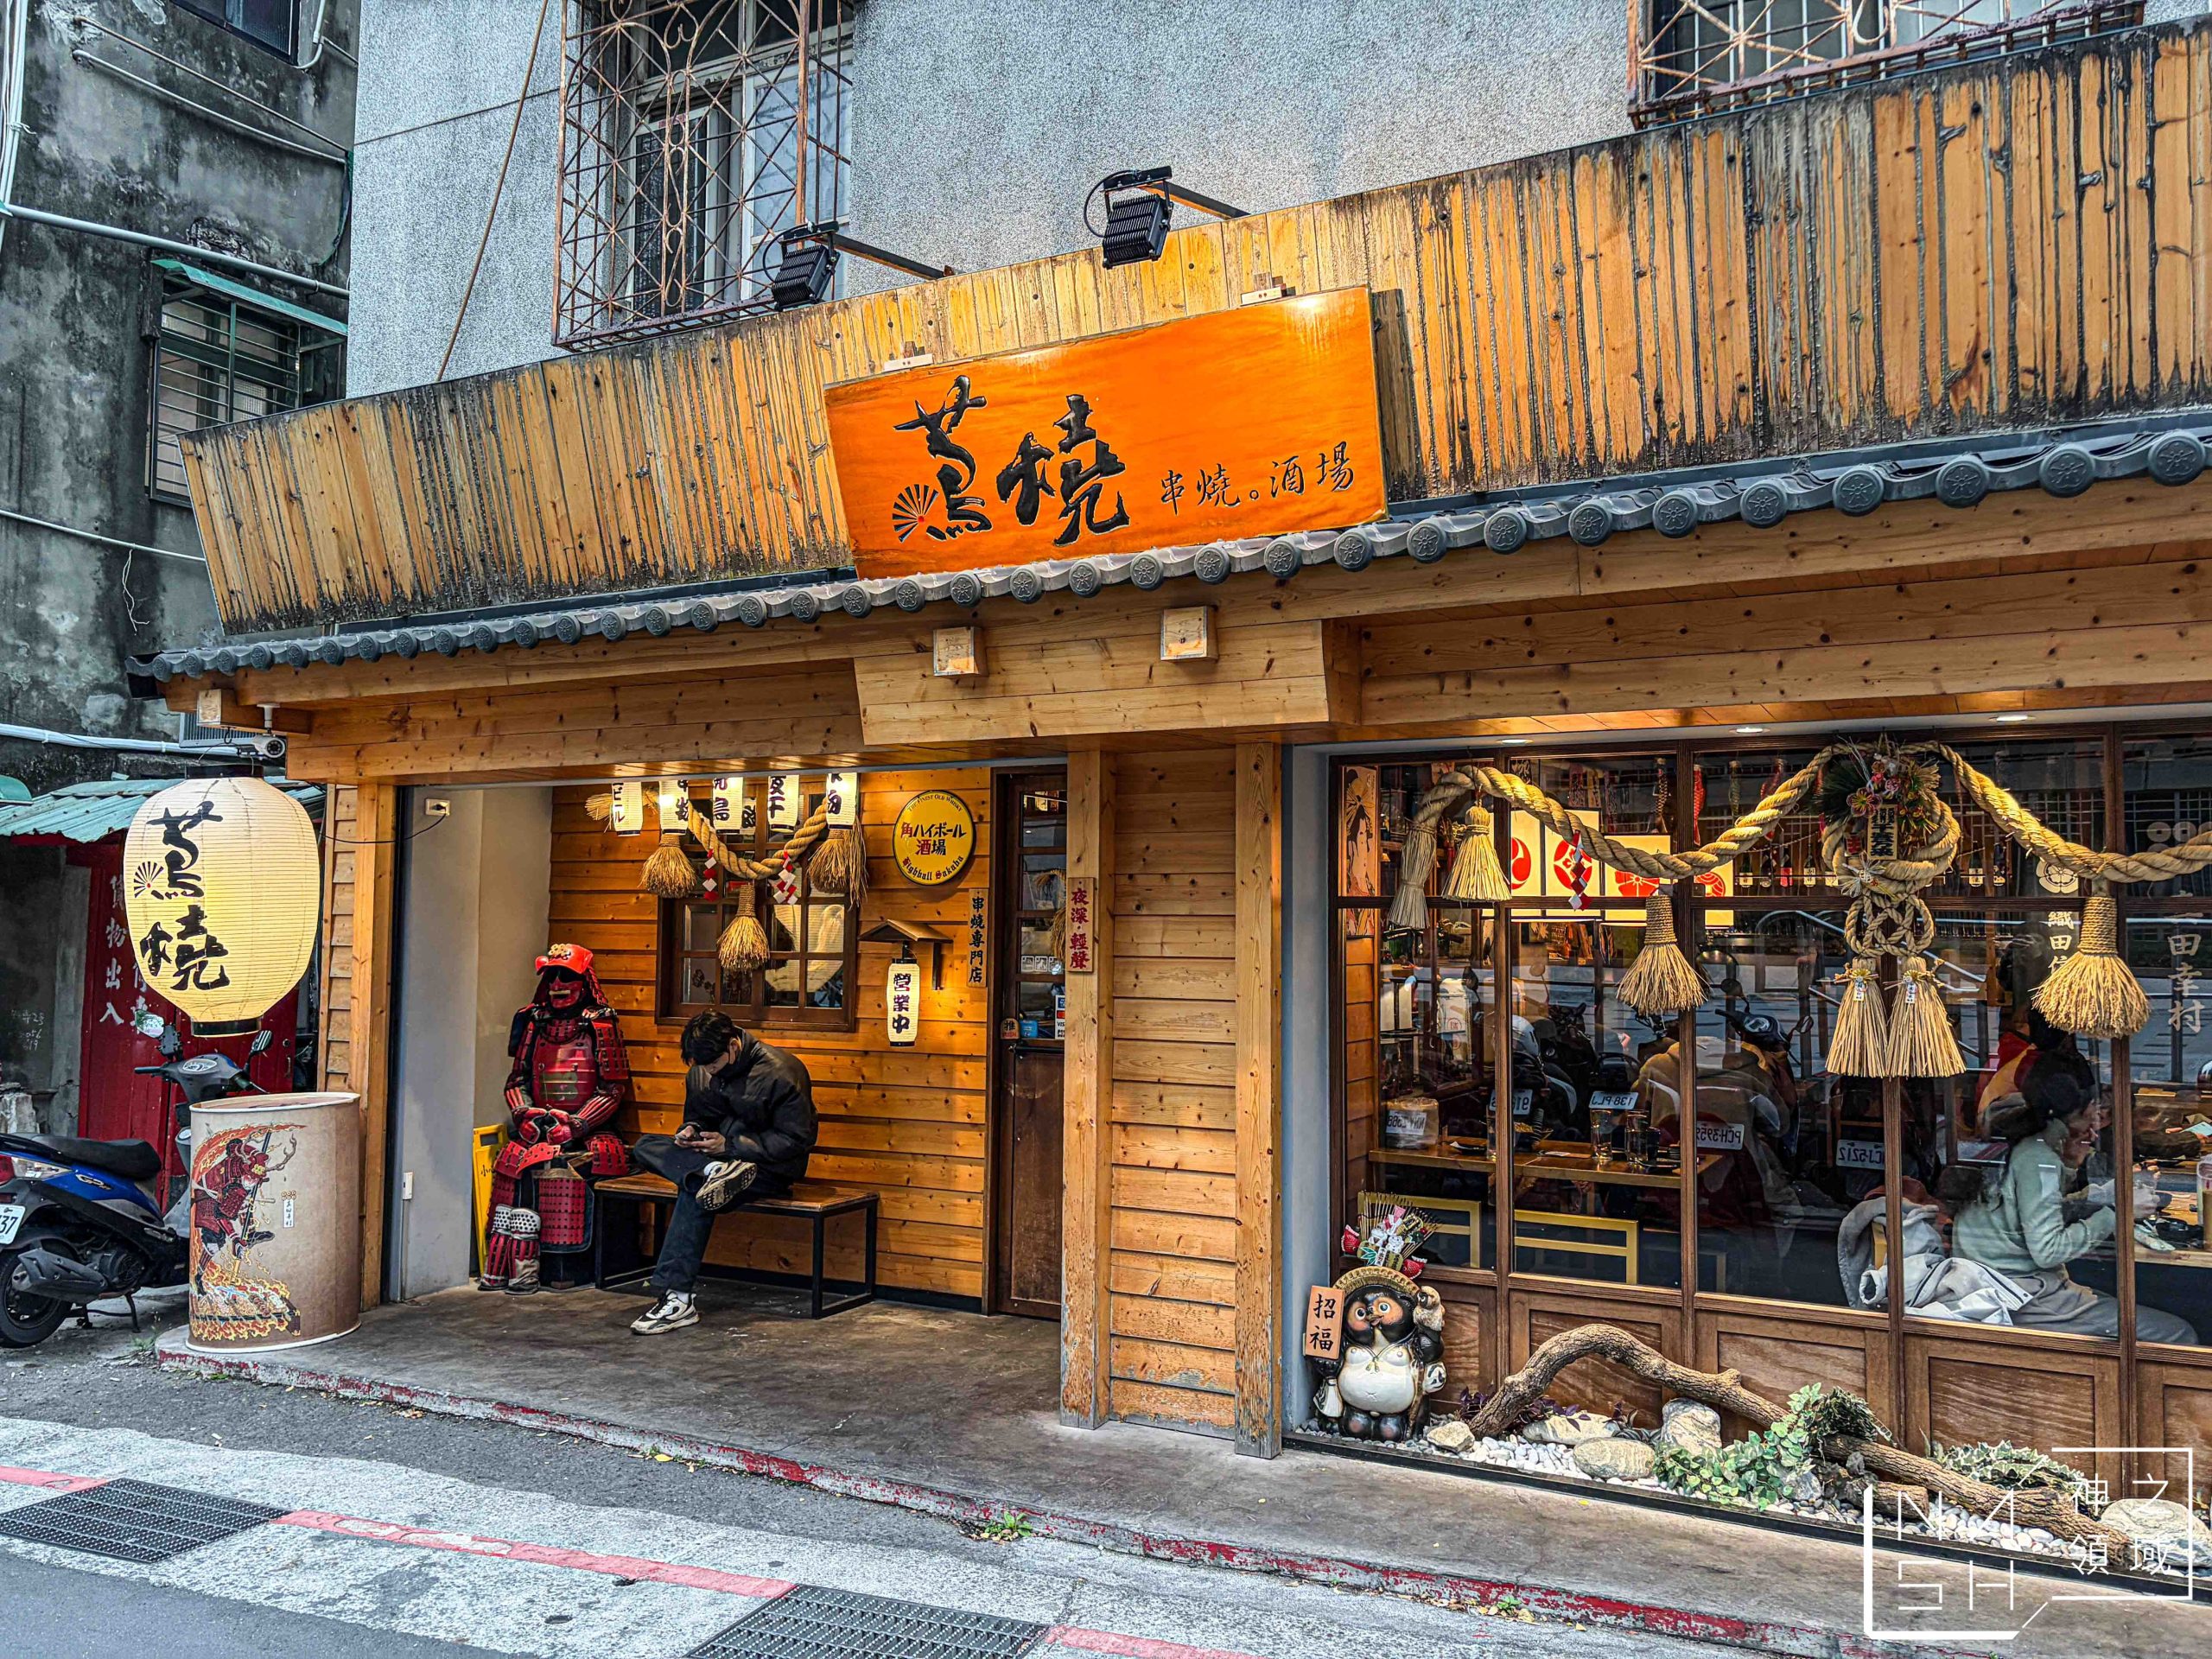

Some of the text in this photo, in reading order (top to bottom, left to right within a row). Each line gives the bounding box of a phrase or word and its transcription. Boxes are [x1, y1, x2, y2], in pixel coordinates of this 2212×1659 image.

[613, 782, 626, 823] ビール
[900, 822, 967, 838] 角ハイボール
[915, 839, 946, 855] 酒場
[935, 855, 963, 880] Sakaba
[969, 897, 985, 983] 串燒專門店
[2165, 890, 2205, 1033] 田幸村
[0, 1217, 18, 1235] 37
[1310, 1294, 1337, 1351] 招福
